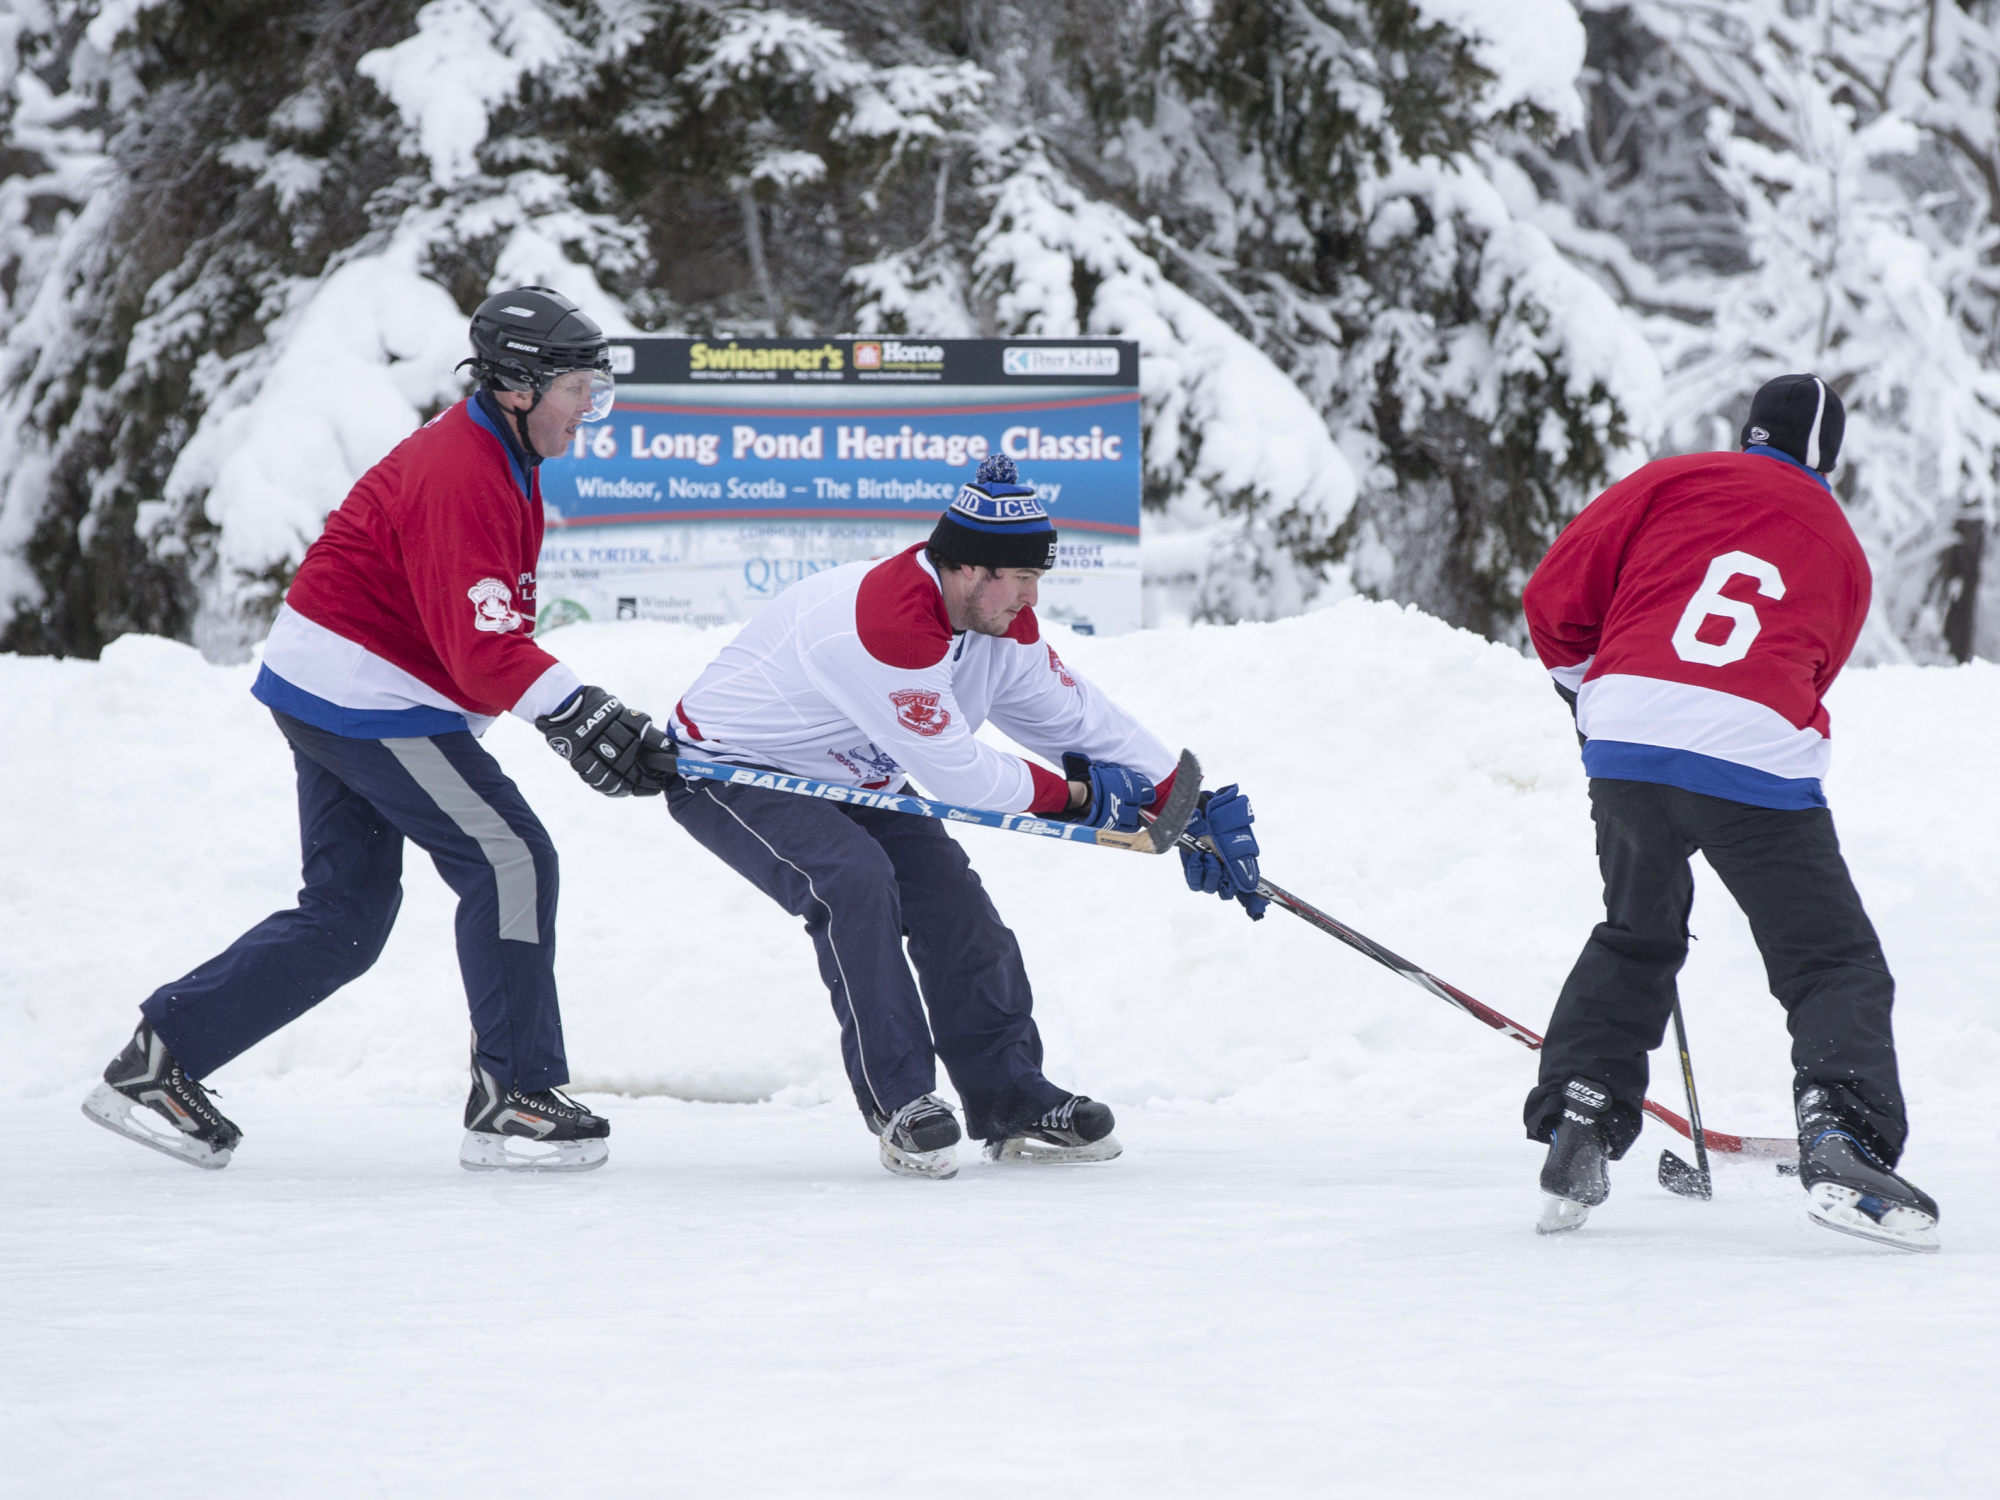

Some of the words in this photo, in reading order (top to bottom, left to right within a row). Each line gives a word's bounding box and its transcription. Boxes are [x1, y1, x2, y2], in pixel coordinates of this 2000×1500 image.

[506, 341, 540, 353] BAUER
[689, 341, 845, 371] Swinamer's
[882, 342, 945, 363] Home
[1032, 352, 1065, 366] Peter
[1068, 352, 1113, 366] Kohler
[631, 425, 721, 467] Long
[732, 425, 824, 460] Pond
[837, 425, 989, 467] Heritage
[1001, 425, 1122, 461] Classic
[575, 476, 663, 502] Windsor,
[669, 477, 722, 499] Nova
[727, 476, 787, 499] Scotia
[813, 476, 852, 499] The
[857, 476, 955, 502] Birthplace
[739, 526, 823, 539] COMMUNITY
[829, 526, 895, 539] SPONSORS
[588, 547, 655, 565] PORTER,
[1059, 545, 1103, 557] REDIT
[477, 587, 506, 599] HOCKEY
[1671, 550, 1787, 667] 6
[897, 696, 933, 705] HOCKEY
[729, 769, 906, 812] BALLISTIK
[1182, 832, 1213, 853] CC
[1567, 1080, 1607, 1101] ultra
